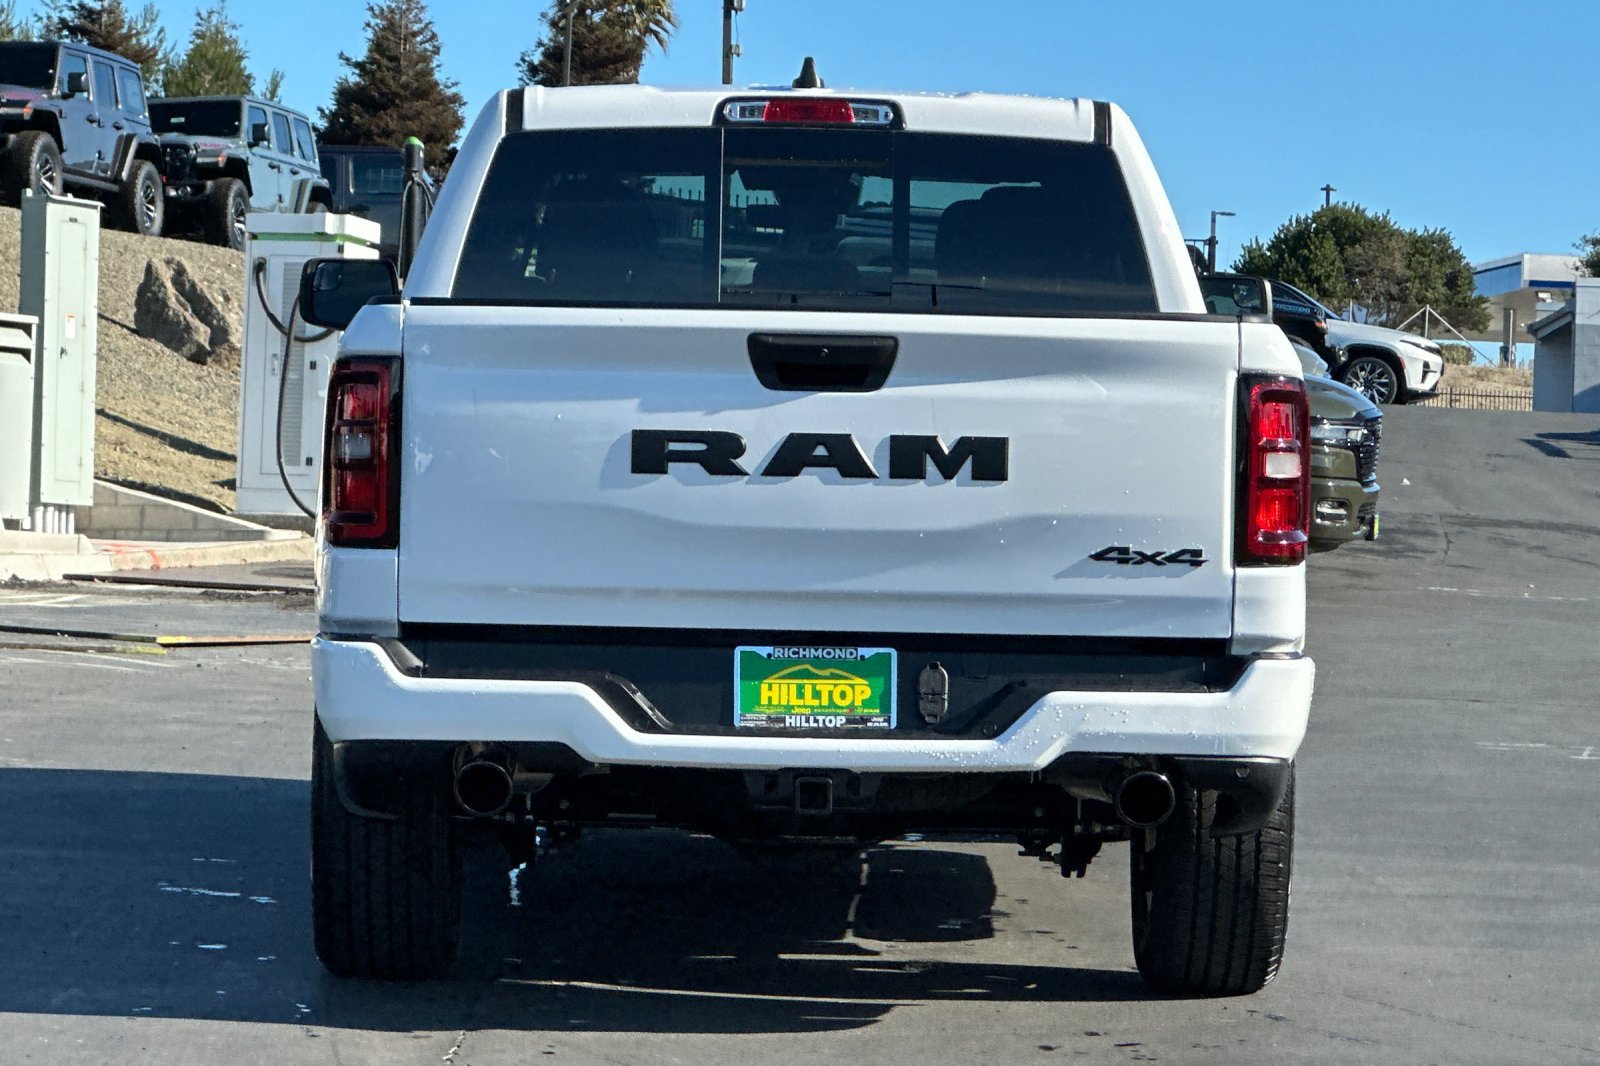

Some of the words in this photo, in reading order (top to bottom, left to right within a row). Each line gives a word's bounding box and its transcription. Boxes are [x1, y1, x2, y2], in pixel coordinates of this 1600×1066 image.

[632, 429, 1009, 481] RAM
[1088, 546, 1209, 567] 4x4
[774, 648, 857, 659] RICHMOND
[761, 684, 871, 706] HILLTOP
[785, 715, 846, 728] HILLTOP
